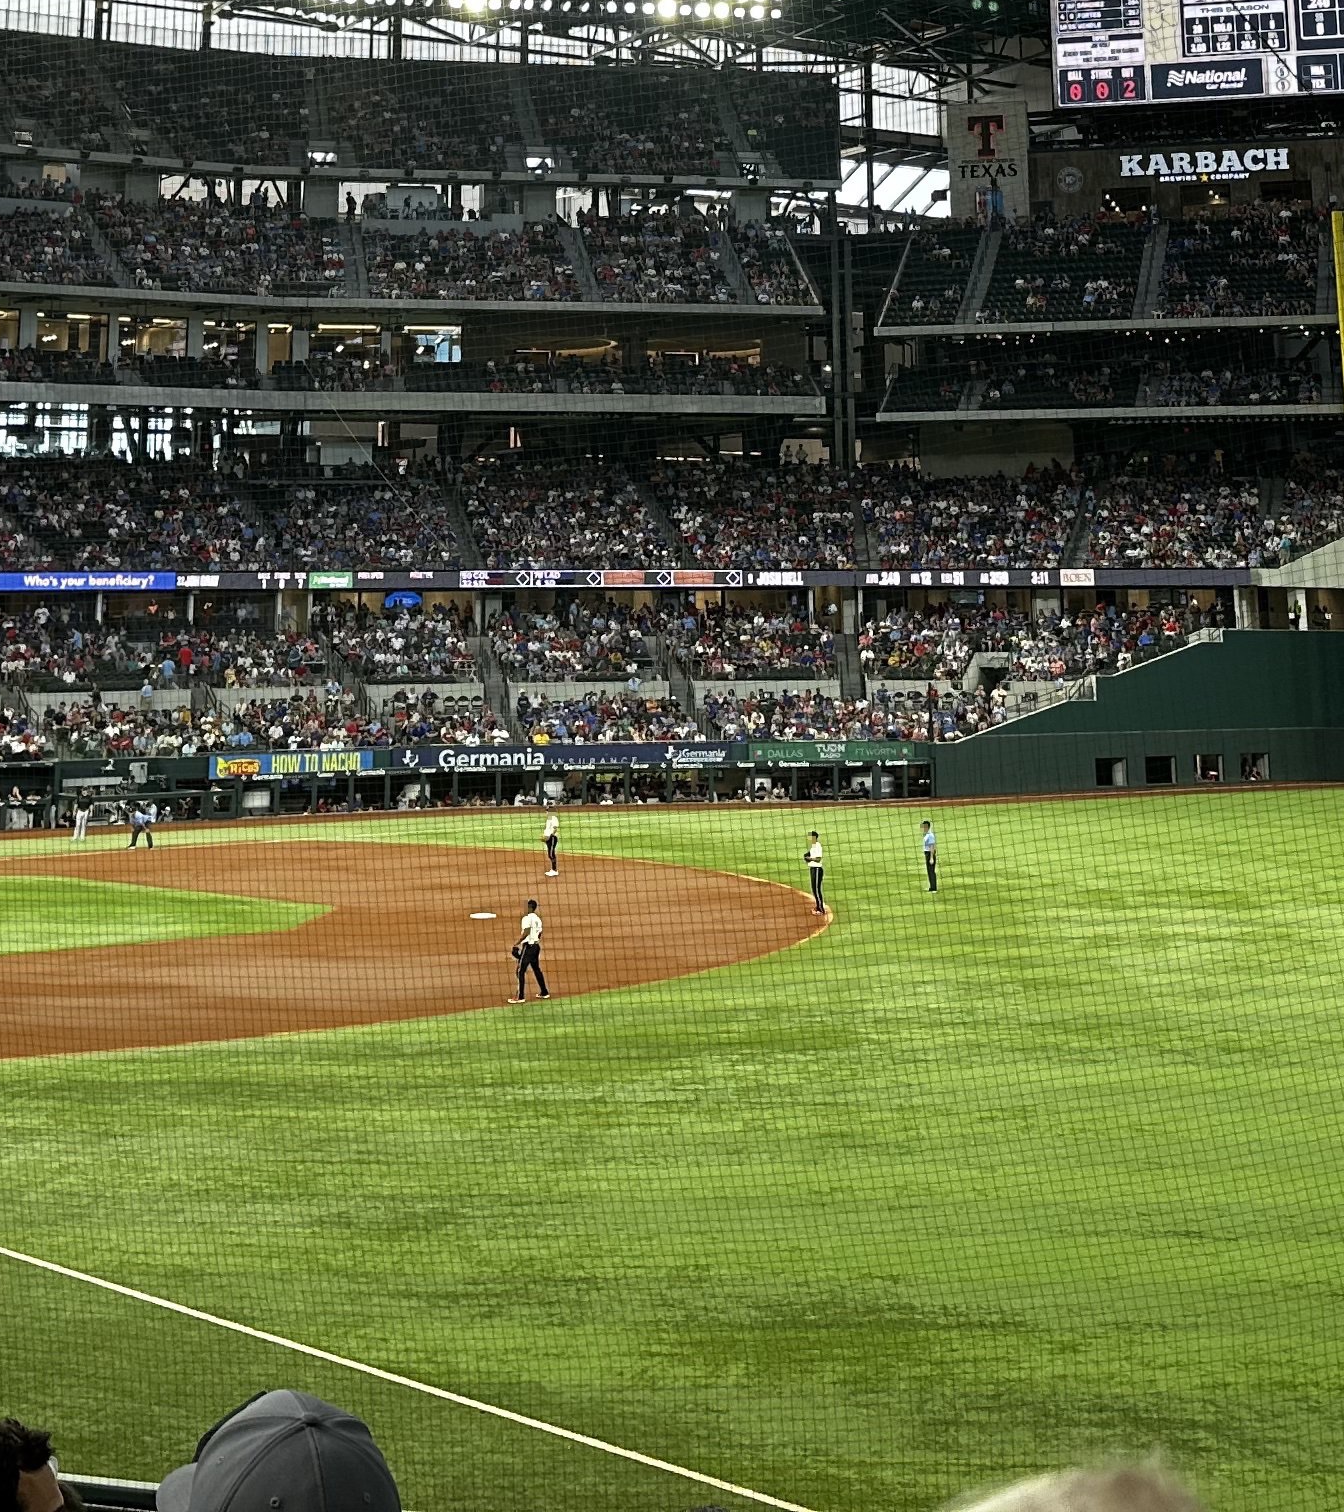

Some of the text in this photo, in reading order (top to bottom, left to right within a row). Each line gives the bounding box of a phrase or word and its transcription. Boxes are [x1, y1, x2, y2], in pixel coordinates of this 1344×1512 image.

[1226, 4, 1269, 13] SEASON
[1069, 80, 1136, 101] 0 0 2
[967, 114, 1006, 158] T
[1119, 148, 1290, 177] KARBACH
[958, 163, 1018, 179] TEXAS
[1159, 172, 1250, 183] BREWING COMPANY
[23, 574, 154, 589] Who's your beneficiary?
[920, 571, 932, 585] 12
[953, 571, 964, 585] 51
[438, 747, 545, 768] Germania
[681, 748, 727, 760] Germania
[767, 748, 804, 758] DALLAS
[864, 746, 897, 756] WORTH
[271, 754, 301, 774] HOW
[303, 753, 319, 773] TO
[321, 751, 361, 772] NACHO
